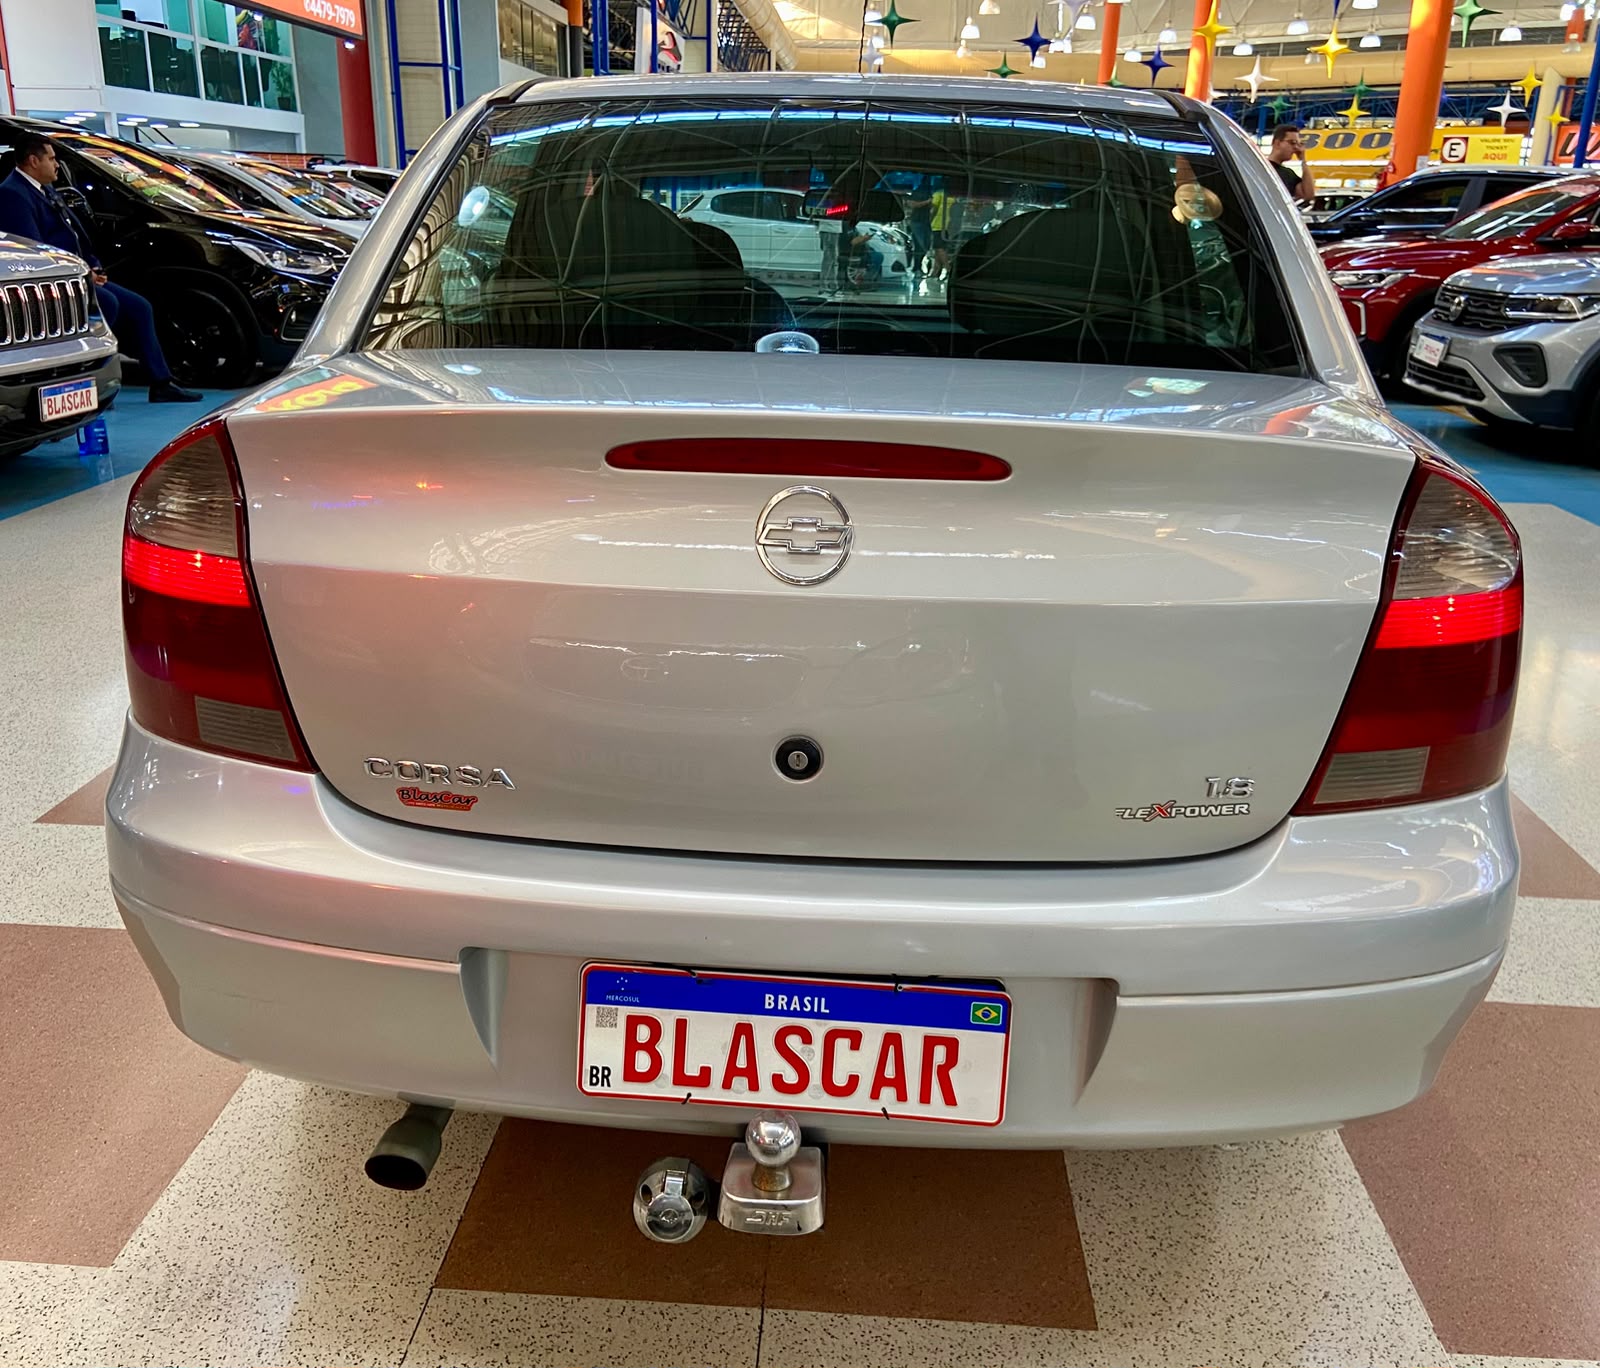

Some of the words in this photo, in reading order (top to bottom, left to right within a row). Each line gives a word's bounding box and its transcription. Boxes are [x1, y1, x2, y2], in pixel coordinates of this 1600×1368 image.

[1448, 142, 1462, 158] E
[47, 389, 92, 416] BLASCAR
[363, 757, 516, 790] CORSA
[605, 994, 641, 1003] MERCOSUL
[764, 993, 830, 1014] BRASIL
[622, 1014, 960, 1107] BLASCAR
[589, 1065, 612, 1087] BR
